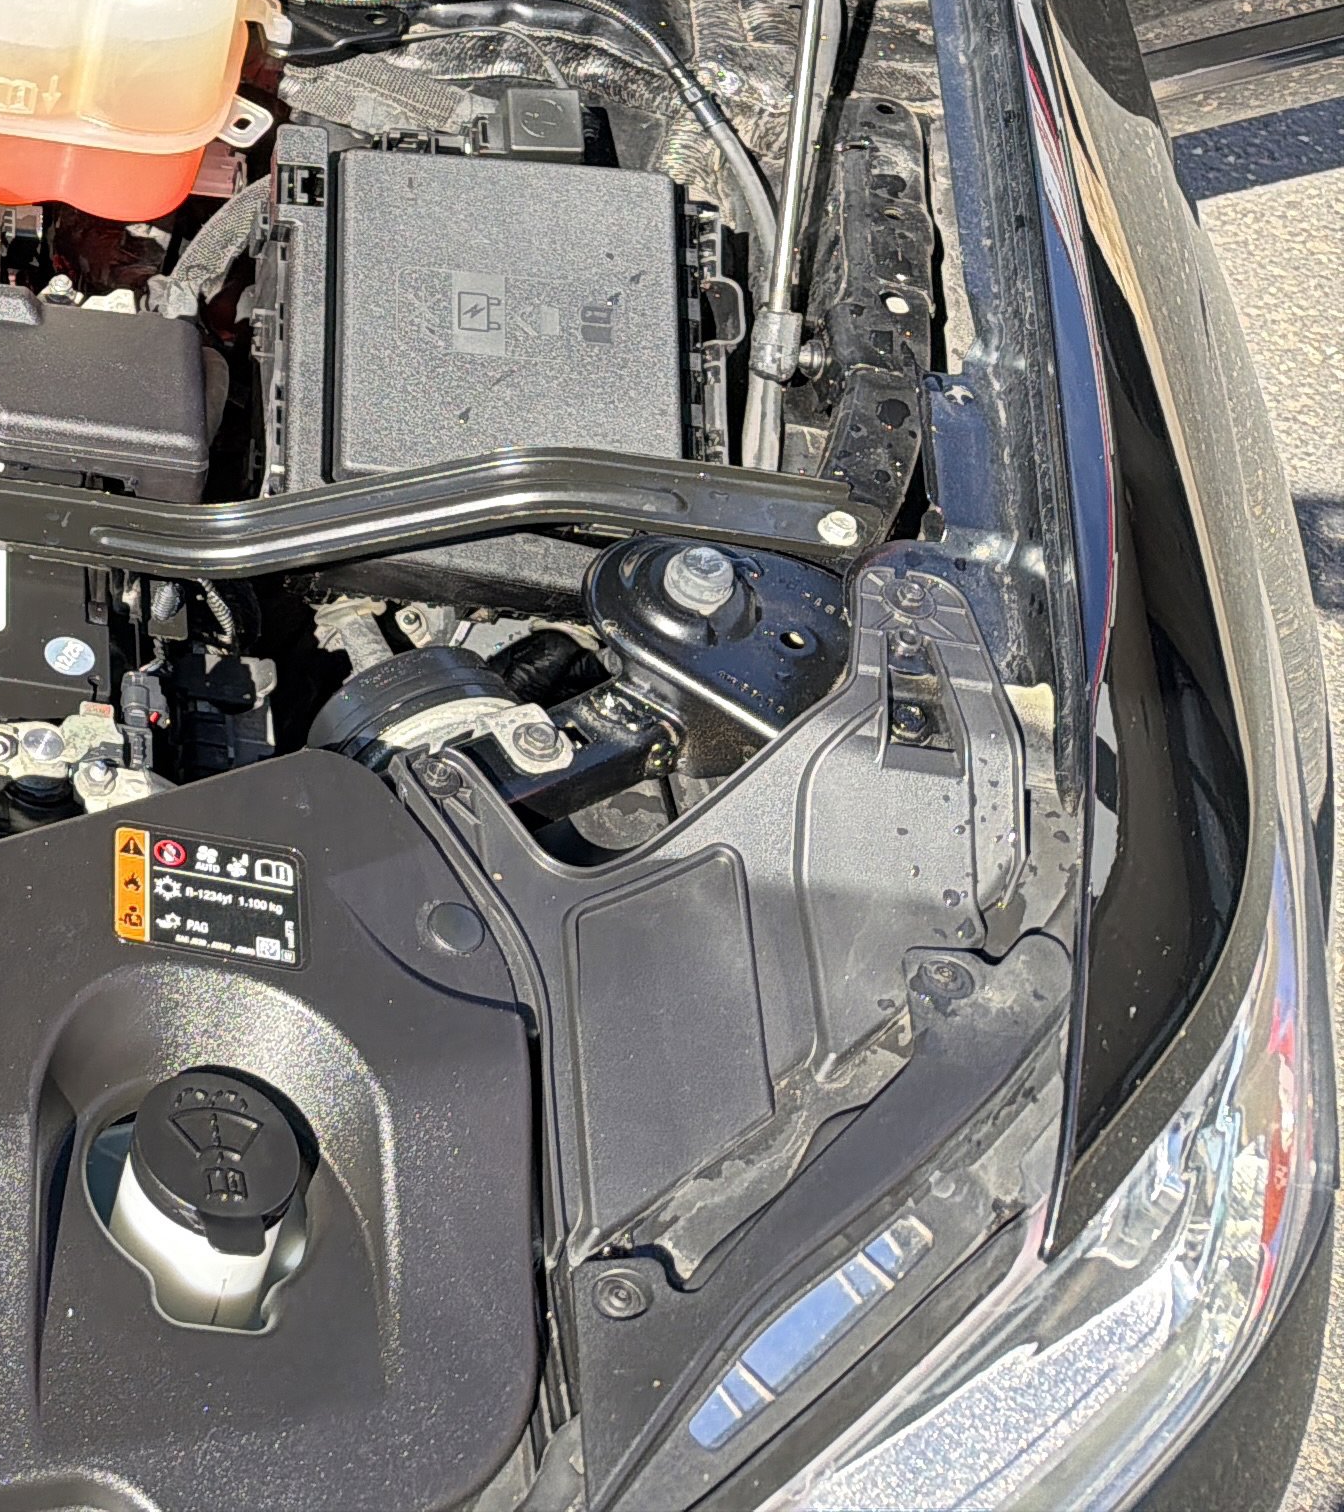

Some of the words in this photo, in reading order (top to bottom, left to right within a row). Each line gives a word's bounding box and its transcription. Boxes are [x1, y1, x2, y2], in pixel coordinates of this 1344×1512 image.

[195, 862, 220, 874] AUTO
[238, 896, 268, 912] 1.100
[268, 901, 284, 916] kg
[186, 919, 209, 934] PAG
